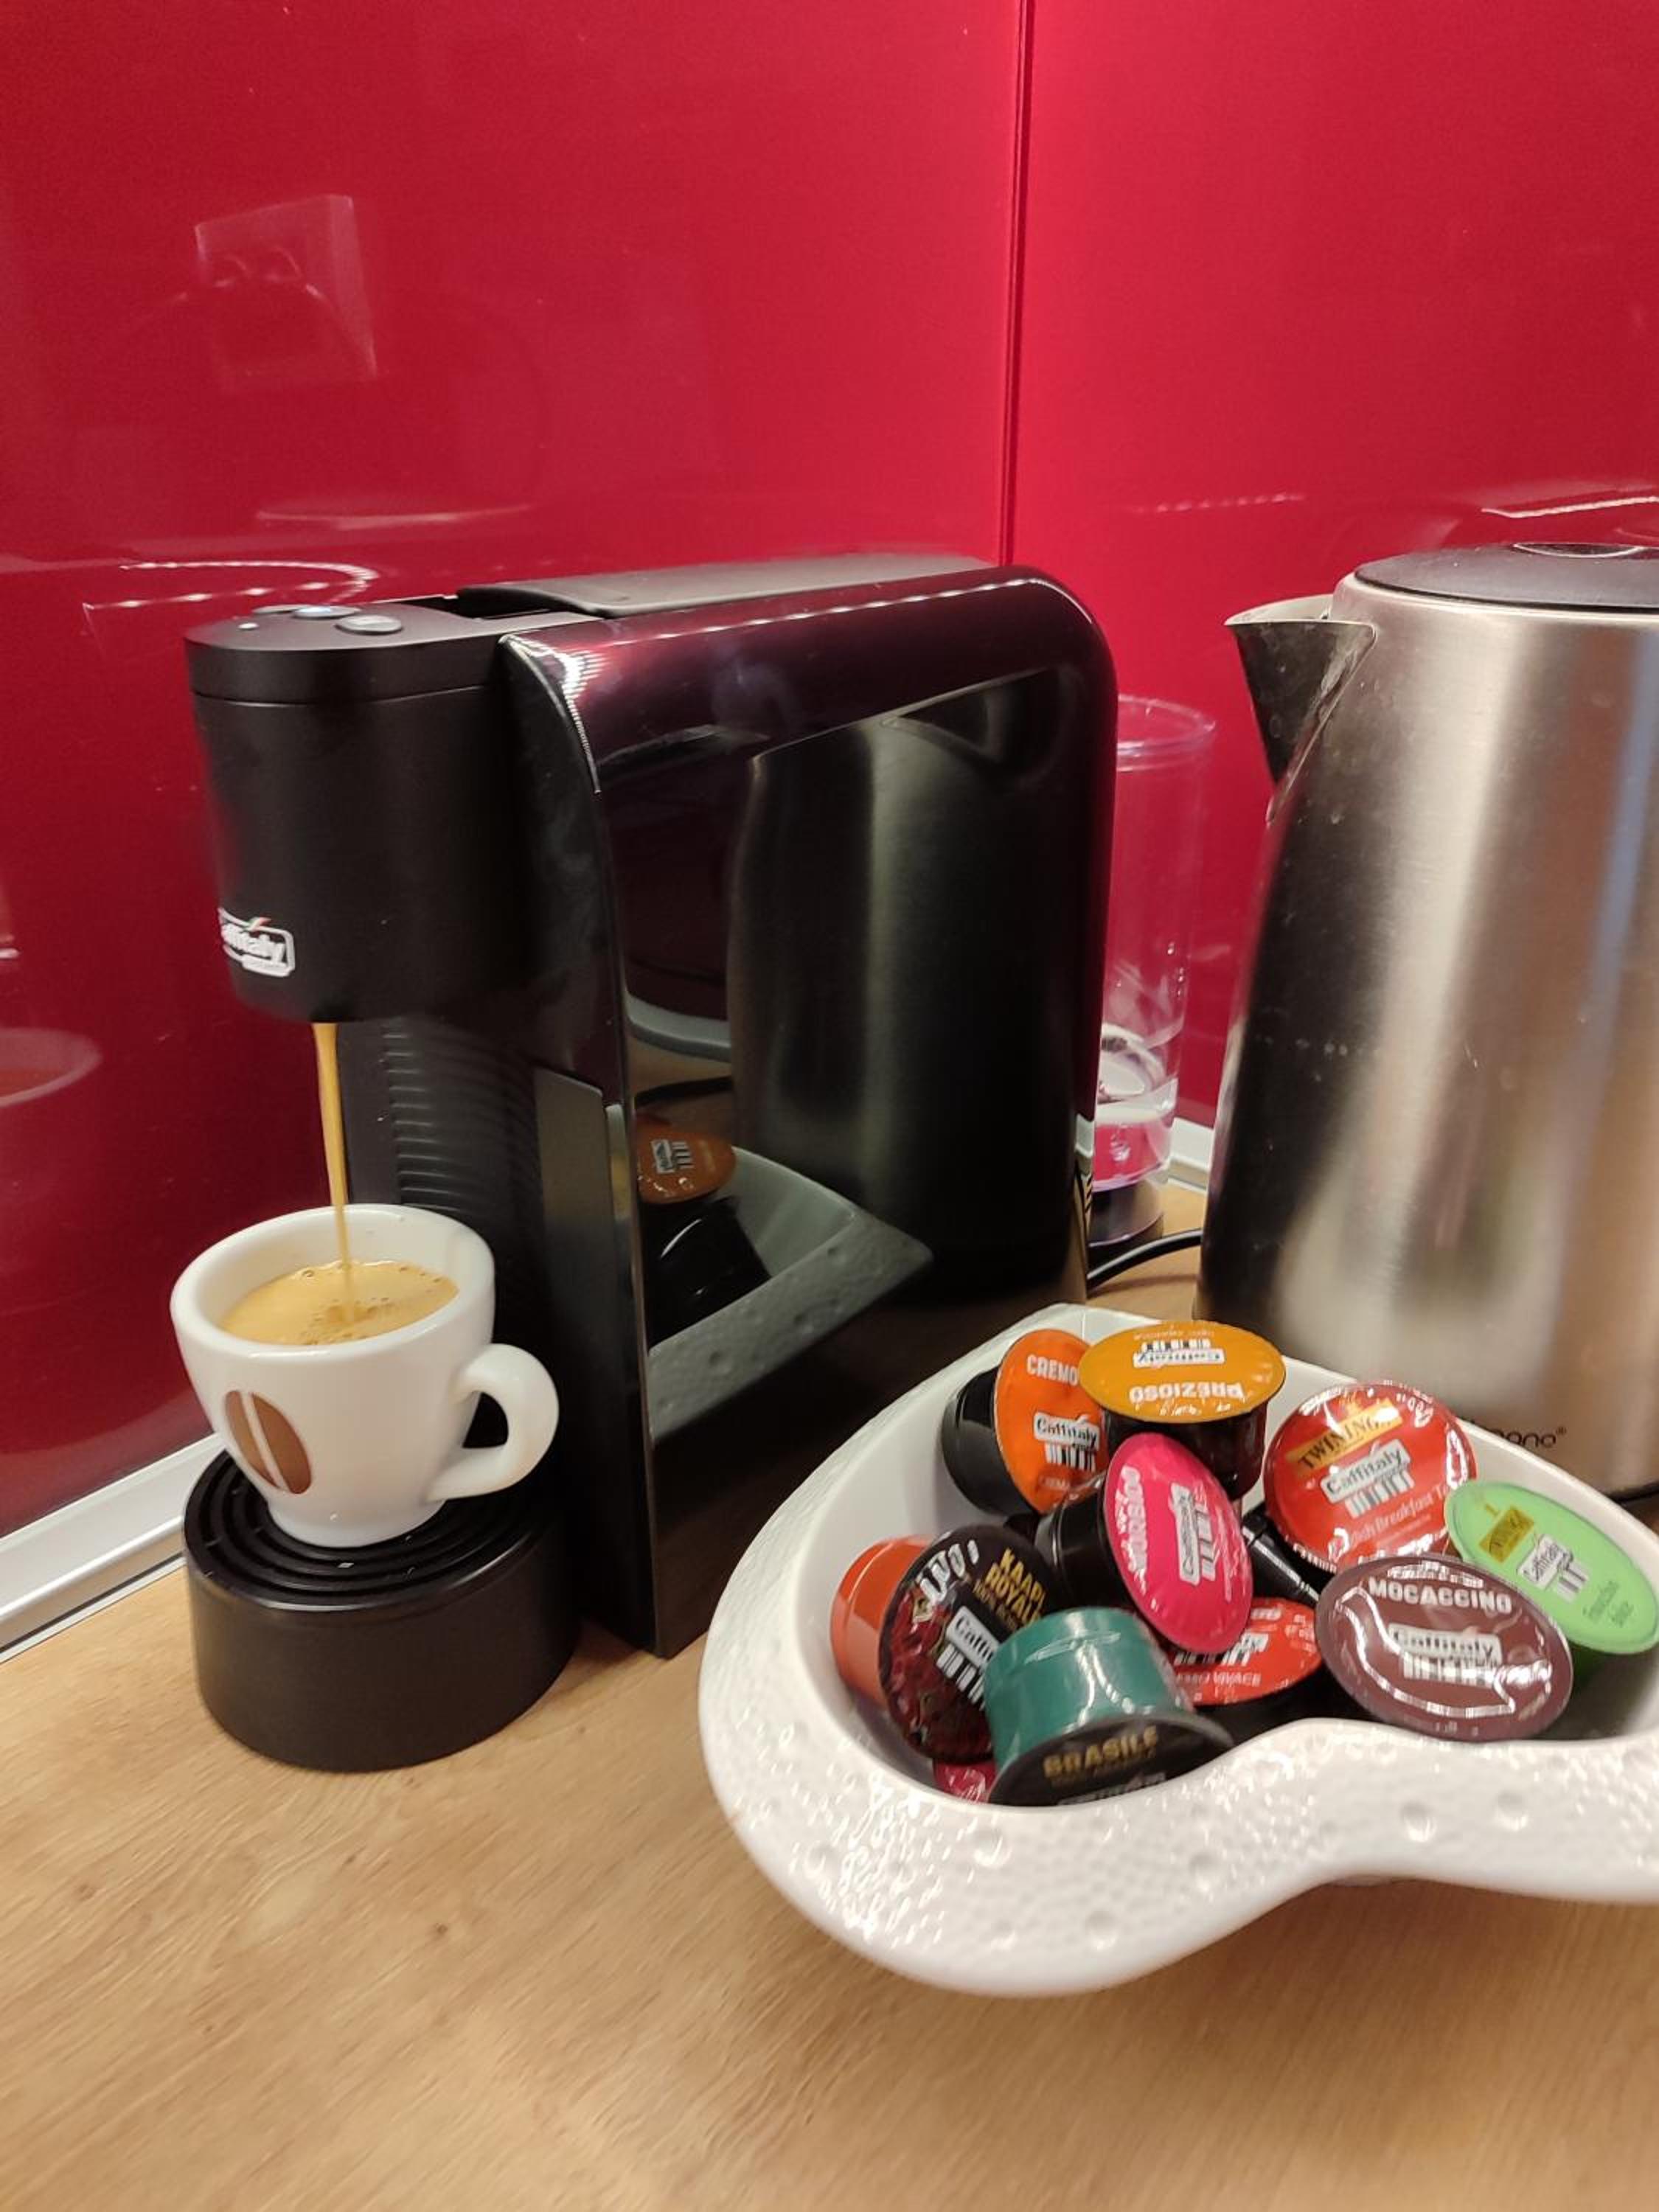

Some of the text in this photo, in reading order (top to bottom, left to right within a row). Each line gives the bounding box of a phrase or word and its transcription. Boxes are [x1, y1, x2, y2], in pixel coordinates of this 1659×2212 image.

[1027, 1354, 1078, 1386] CREMO
[1326, 1449, 1402, 1495] Caffitaly
[1368, 1576, 1512, 1613] MOCACCINO
